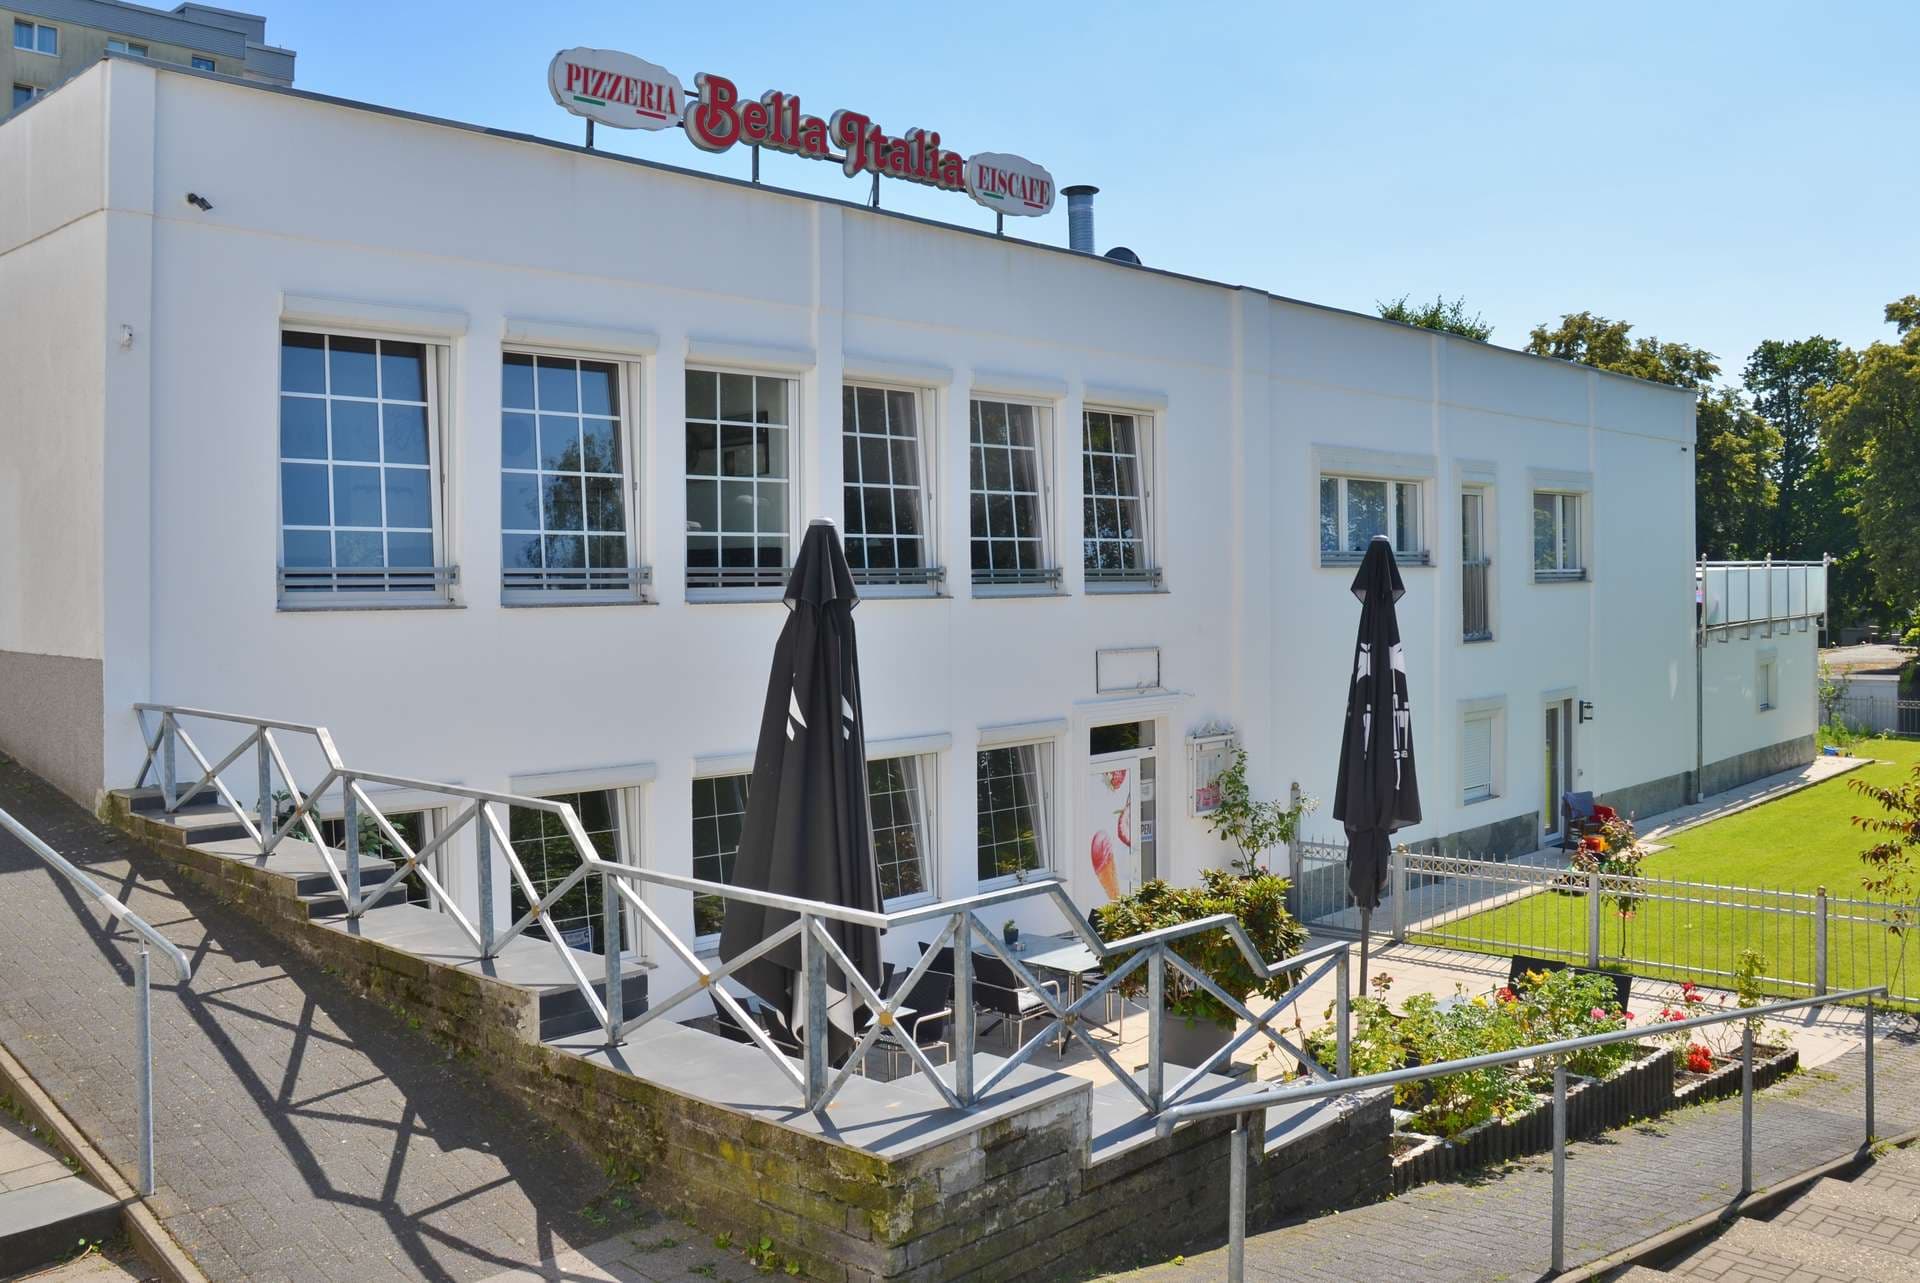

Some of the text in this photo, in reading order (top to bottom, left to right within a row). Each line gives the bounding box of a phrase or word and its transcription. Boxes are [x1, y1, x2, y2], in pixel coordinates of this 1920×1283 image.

[566, 62, 677, 115] PIZZERIA
[692, 74, 965, 187] Bella Italia
[976, 163, 1050, 206] EISCAFE
